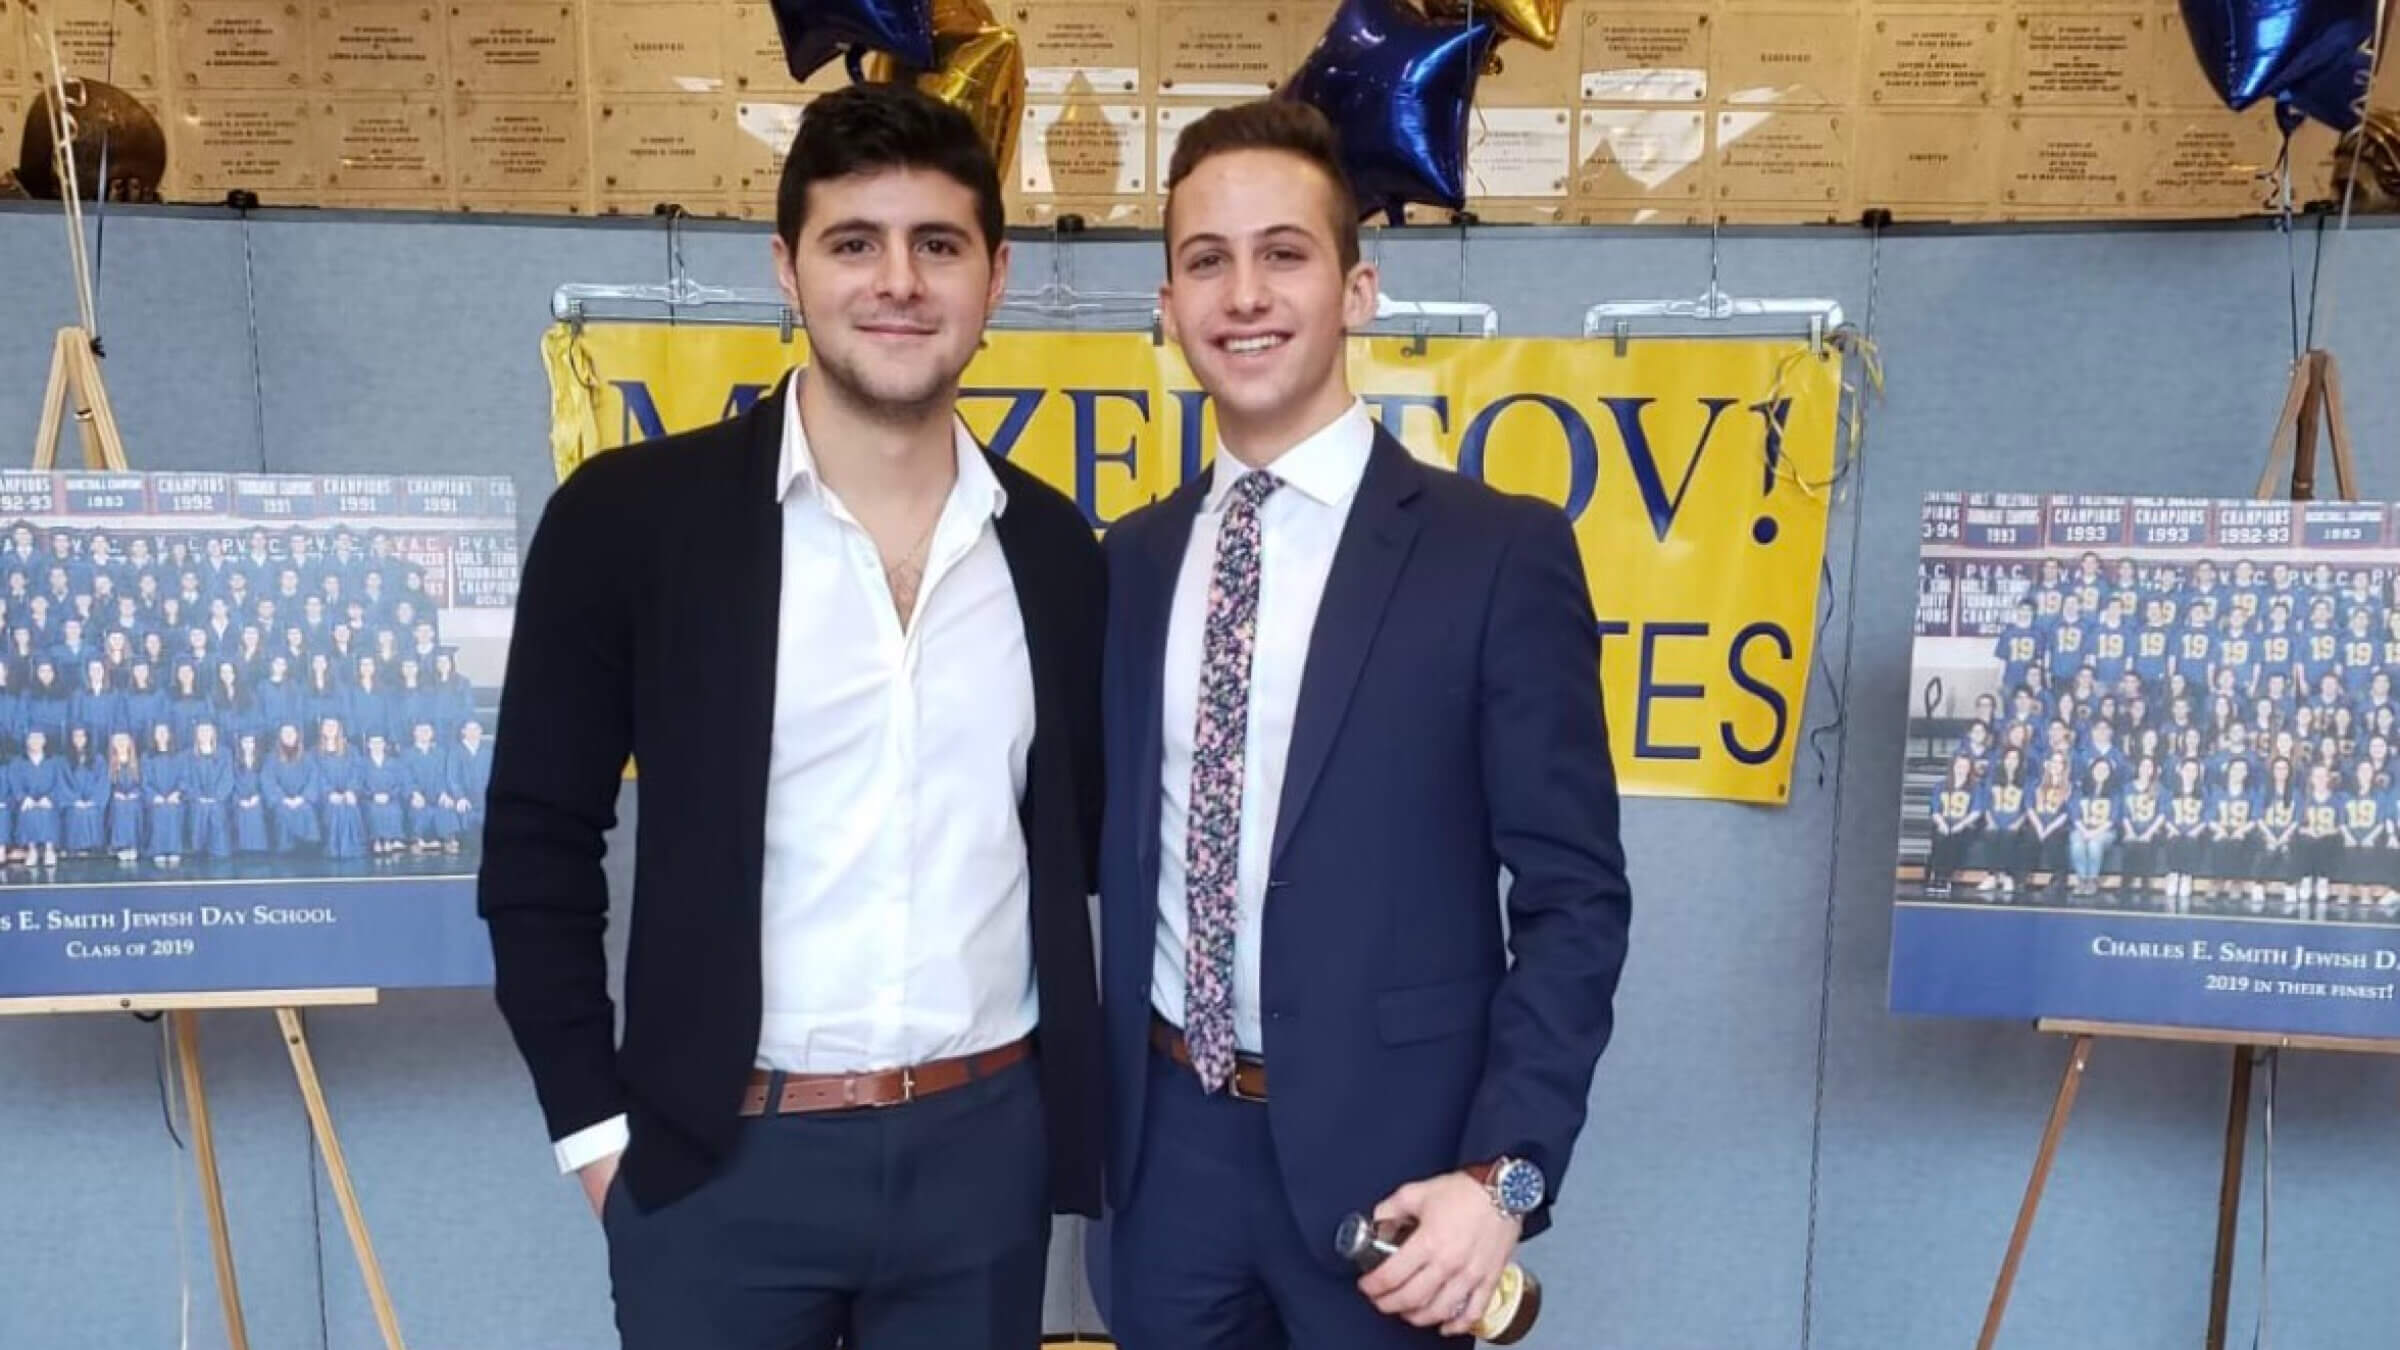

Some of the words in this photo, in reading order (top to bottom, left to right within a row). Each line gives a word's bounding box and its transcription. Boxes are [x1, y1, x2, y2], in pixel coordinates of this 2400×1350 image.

[1358, 391, 1794, 545] TOV!
[152, 938, 195, 956] 2019
[2206, 974, 2249, 991] 2019
